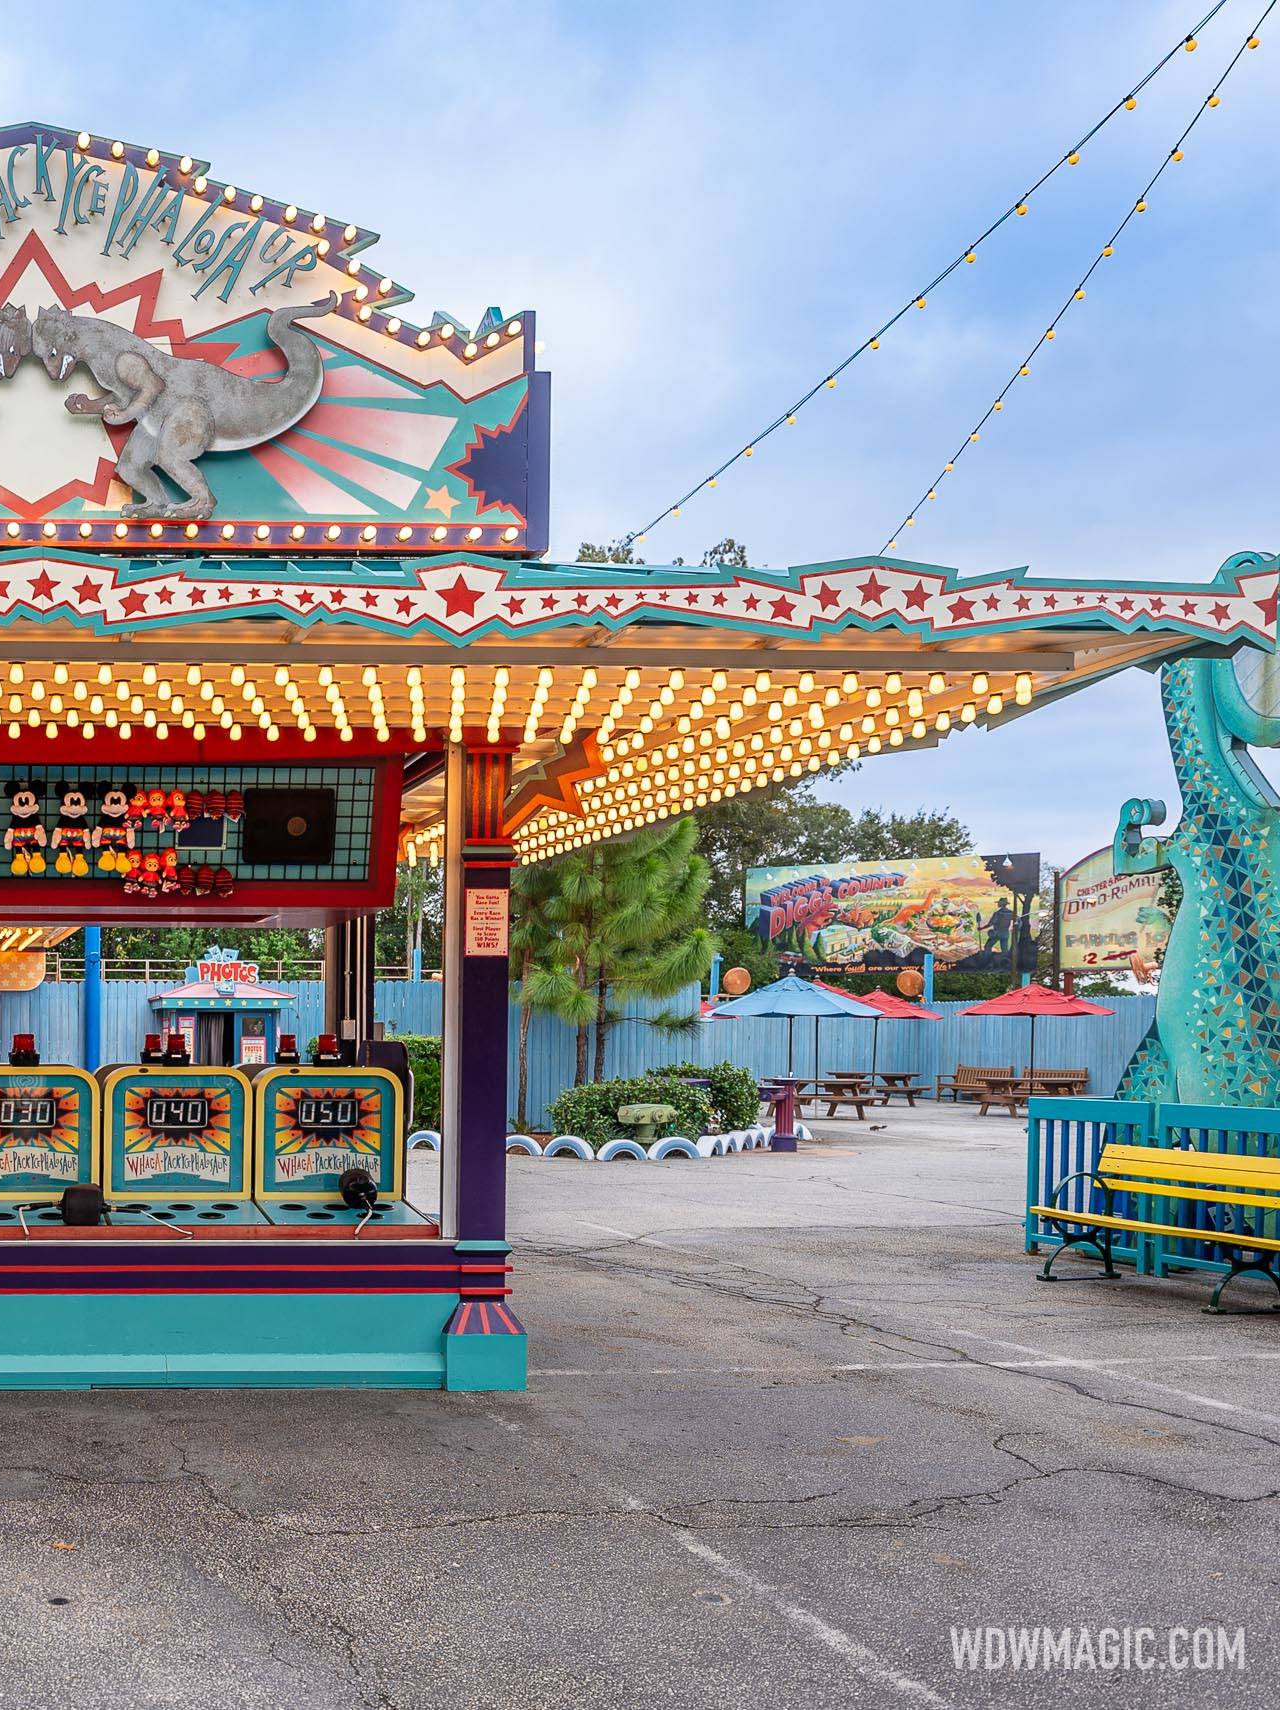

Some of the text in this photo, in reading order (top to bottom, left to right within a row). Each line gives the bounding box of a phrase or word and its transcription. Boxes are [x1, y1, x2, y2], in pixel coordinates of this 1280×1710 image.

[1077, 882, 1107, 897] CHESTER
[770, 875, 908, 939] DIGGS COUNTY
[1083, 952, 1097, 965] $2
[199, 962, 257, 984] PHOTOS
[0, 1101, 51, 1123] 030
[152, 1100, 202, 1123] 040
[302, 1101, 352, 1123] 050
